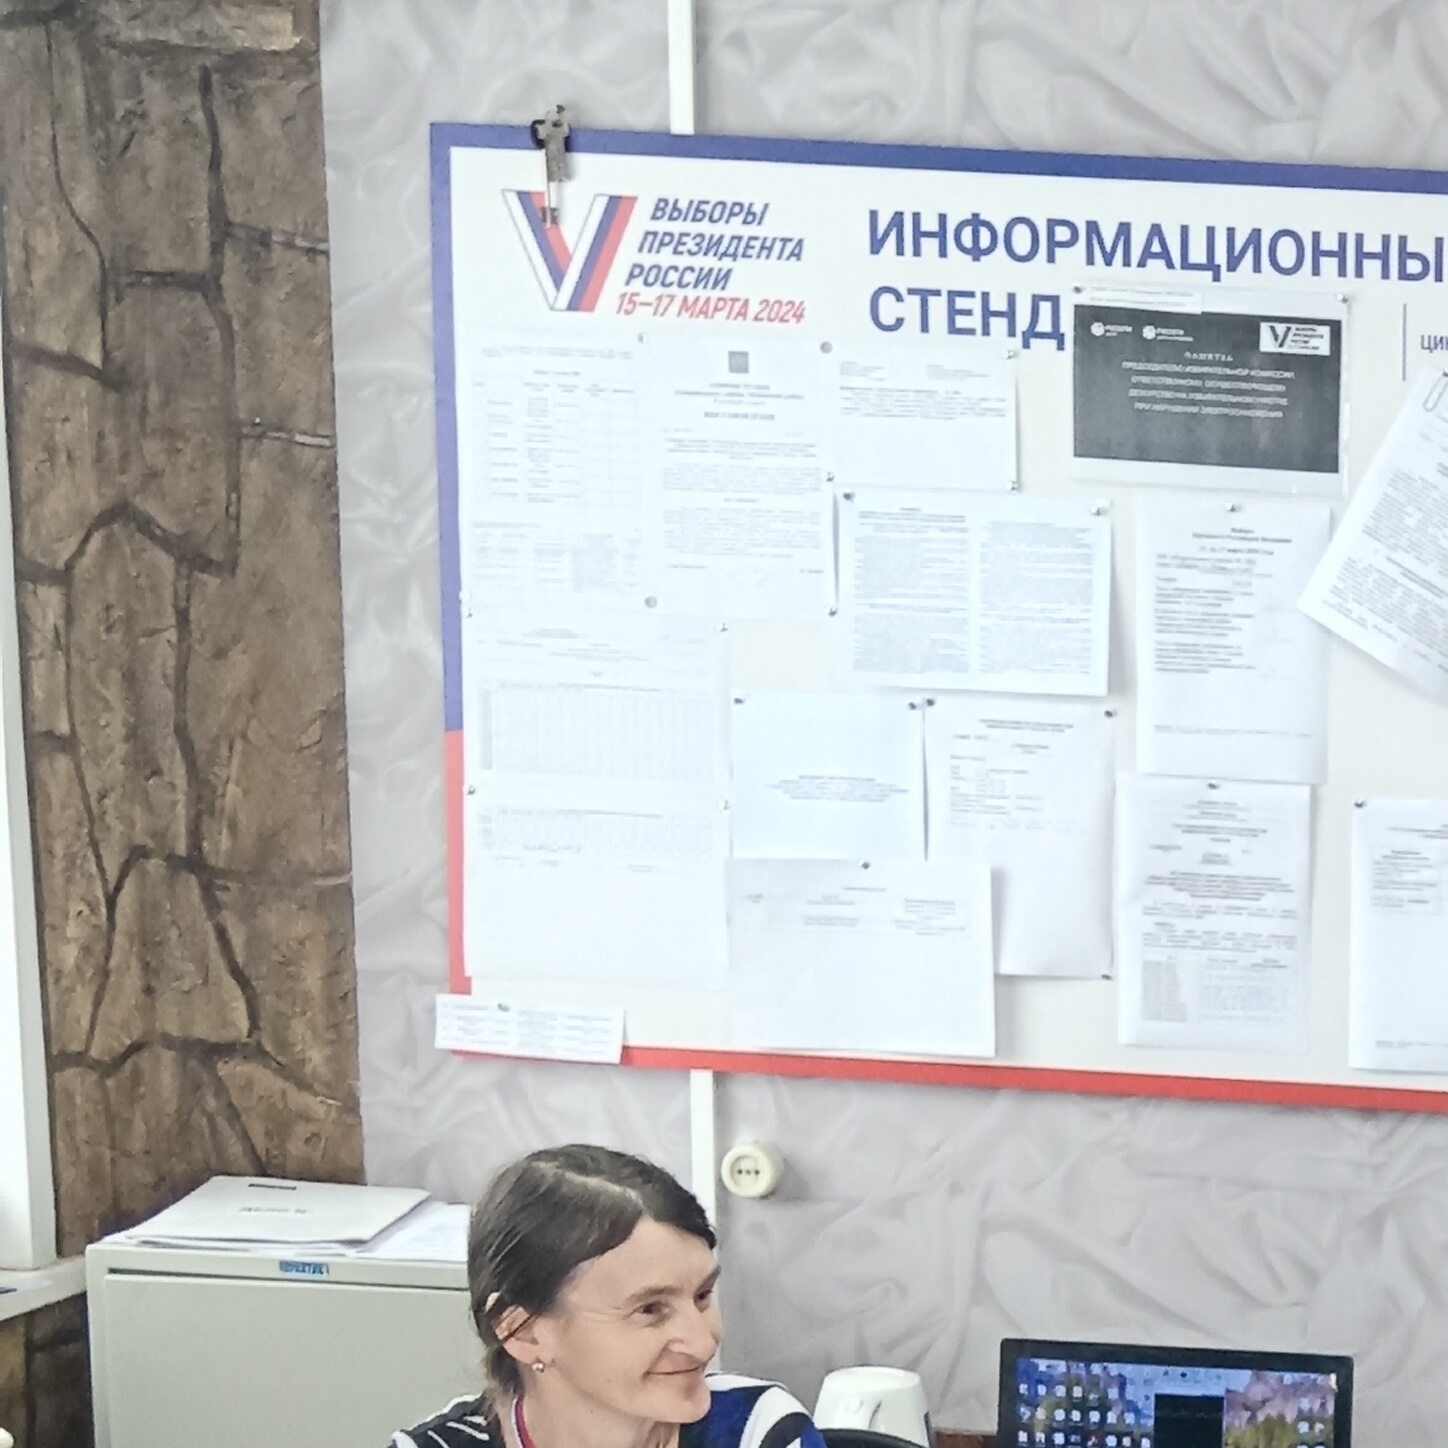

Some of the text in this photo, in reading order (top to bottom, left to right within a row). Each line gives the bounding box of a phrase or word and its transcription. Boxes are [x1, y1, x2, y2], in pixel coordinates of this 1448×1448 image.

[650, 198, 770, 226] ВЫБОРЫ
[637, 230, 805, 263] ПРЕЗИДЕНТА
[624, 263, 733, 291] РОССИИ
[676, 295, 750, 321] МАРТА
[752, 299, 806, 324] 2024
[869, 287, 1065, 351] СТЕНД
